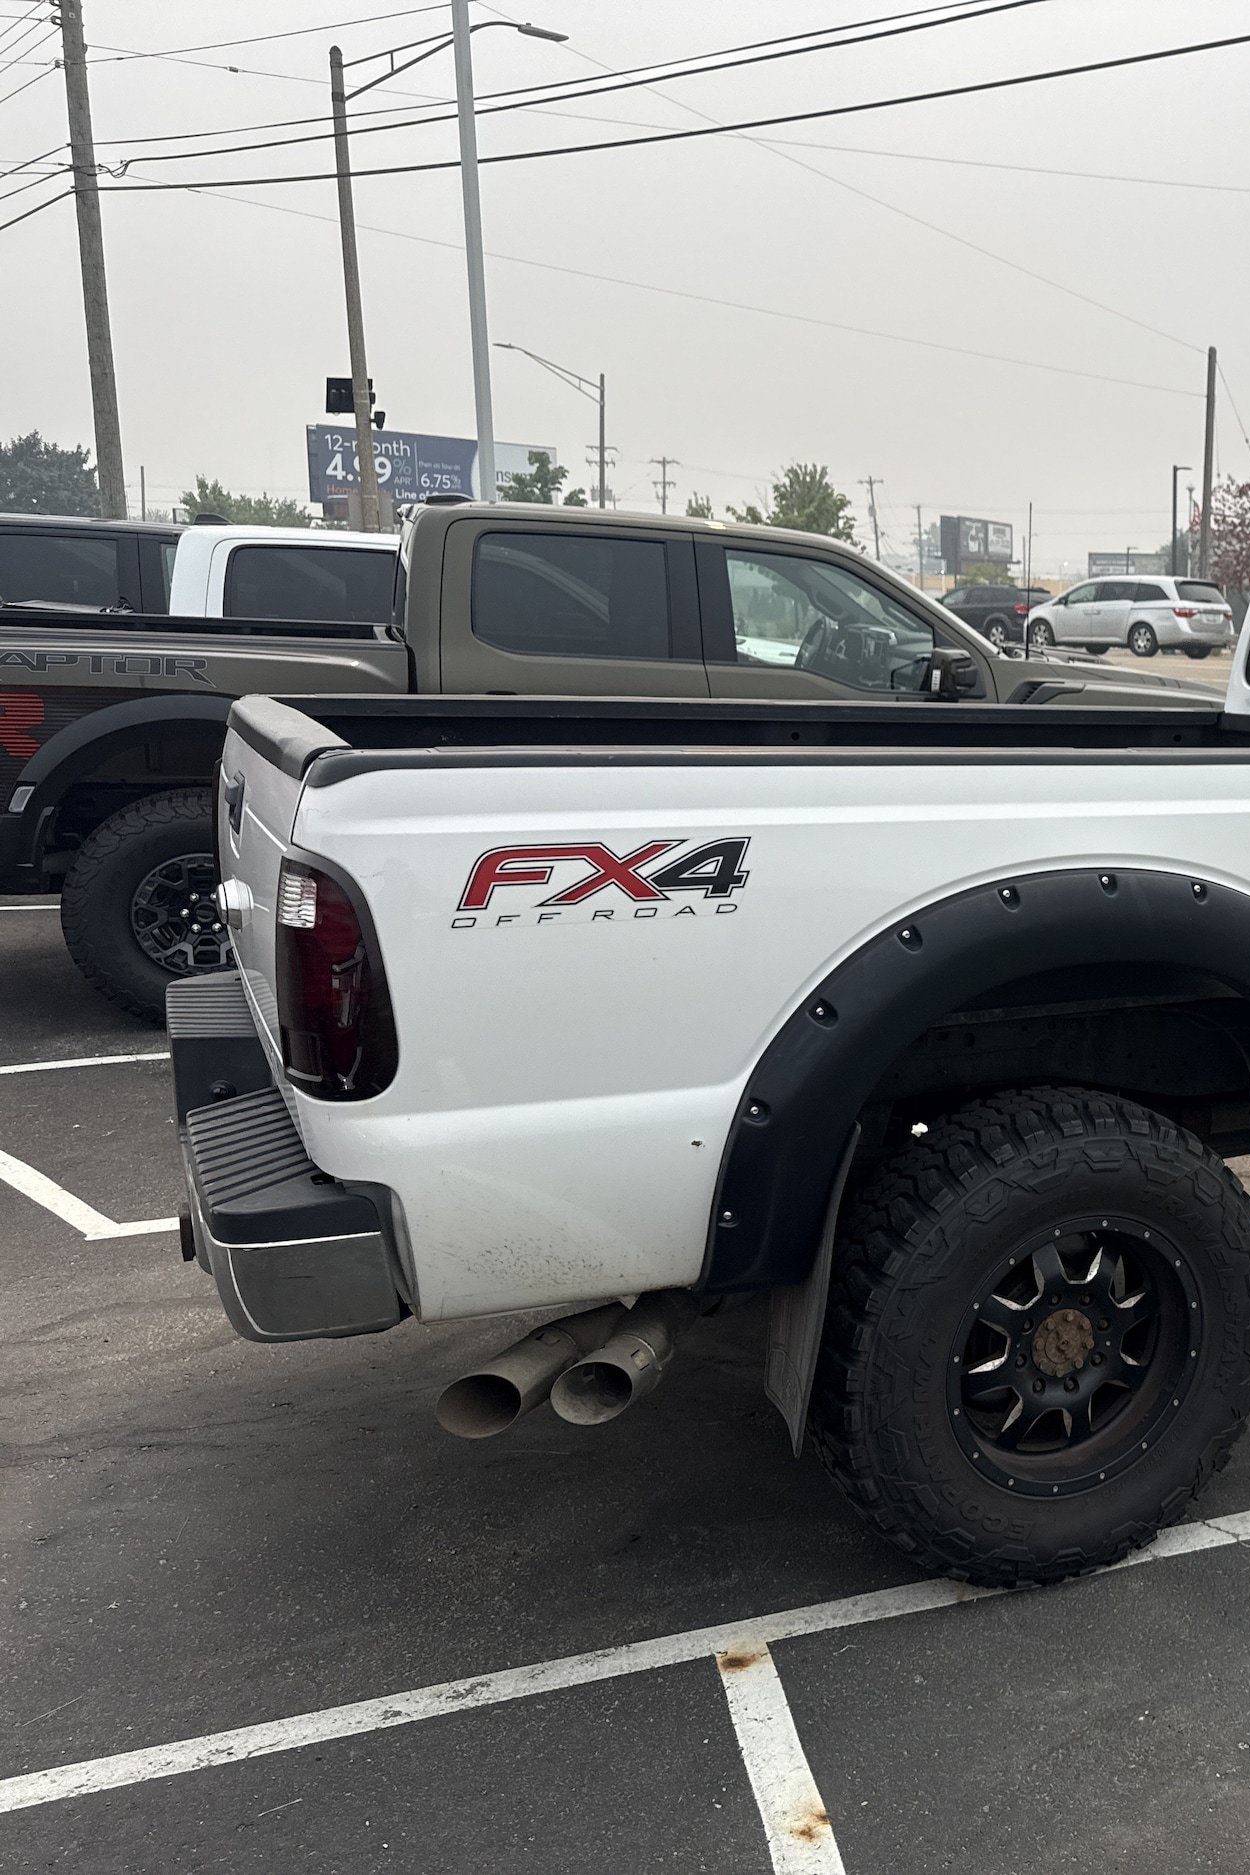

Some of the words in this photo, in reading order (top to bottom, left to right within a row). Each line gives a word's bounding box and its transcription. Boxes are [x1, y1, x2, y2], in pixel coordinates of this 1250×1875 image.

[396, 488, 417, 499] Line
[0, 652, 217, 688] APTOR
[456, 836, 751, 911] FX4
[451, 912, 561, 929] OFF
[592, 903, 738, 921] ROAD
